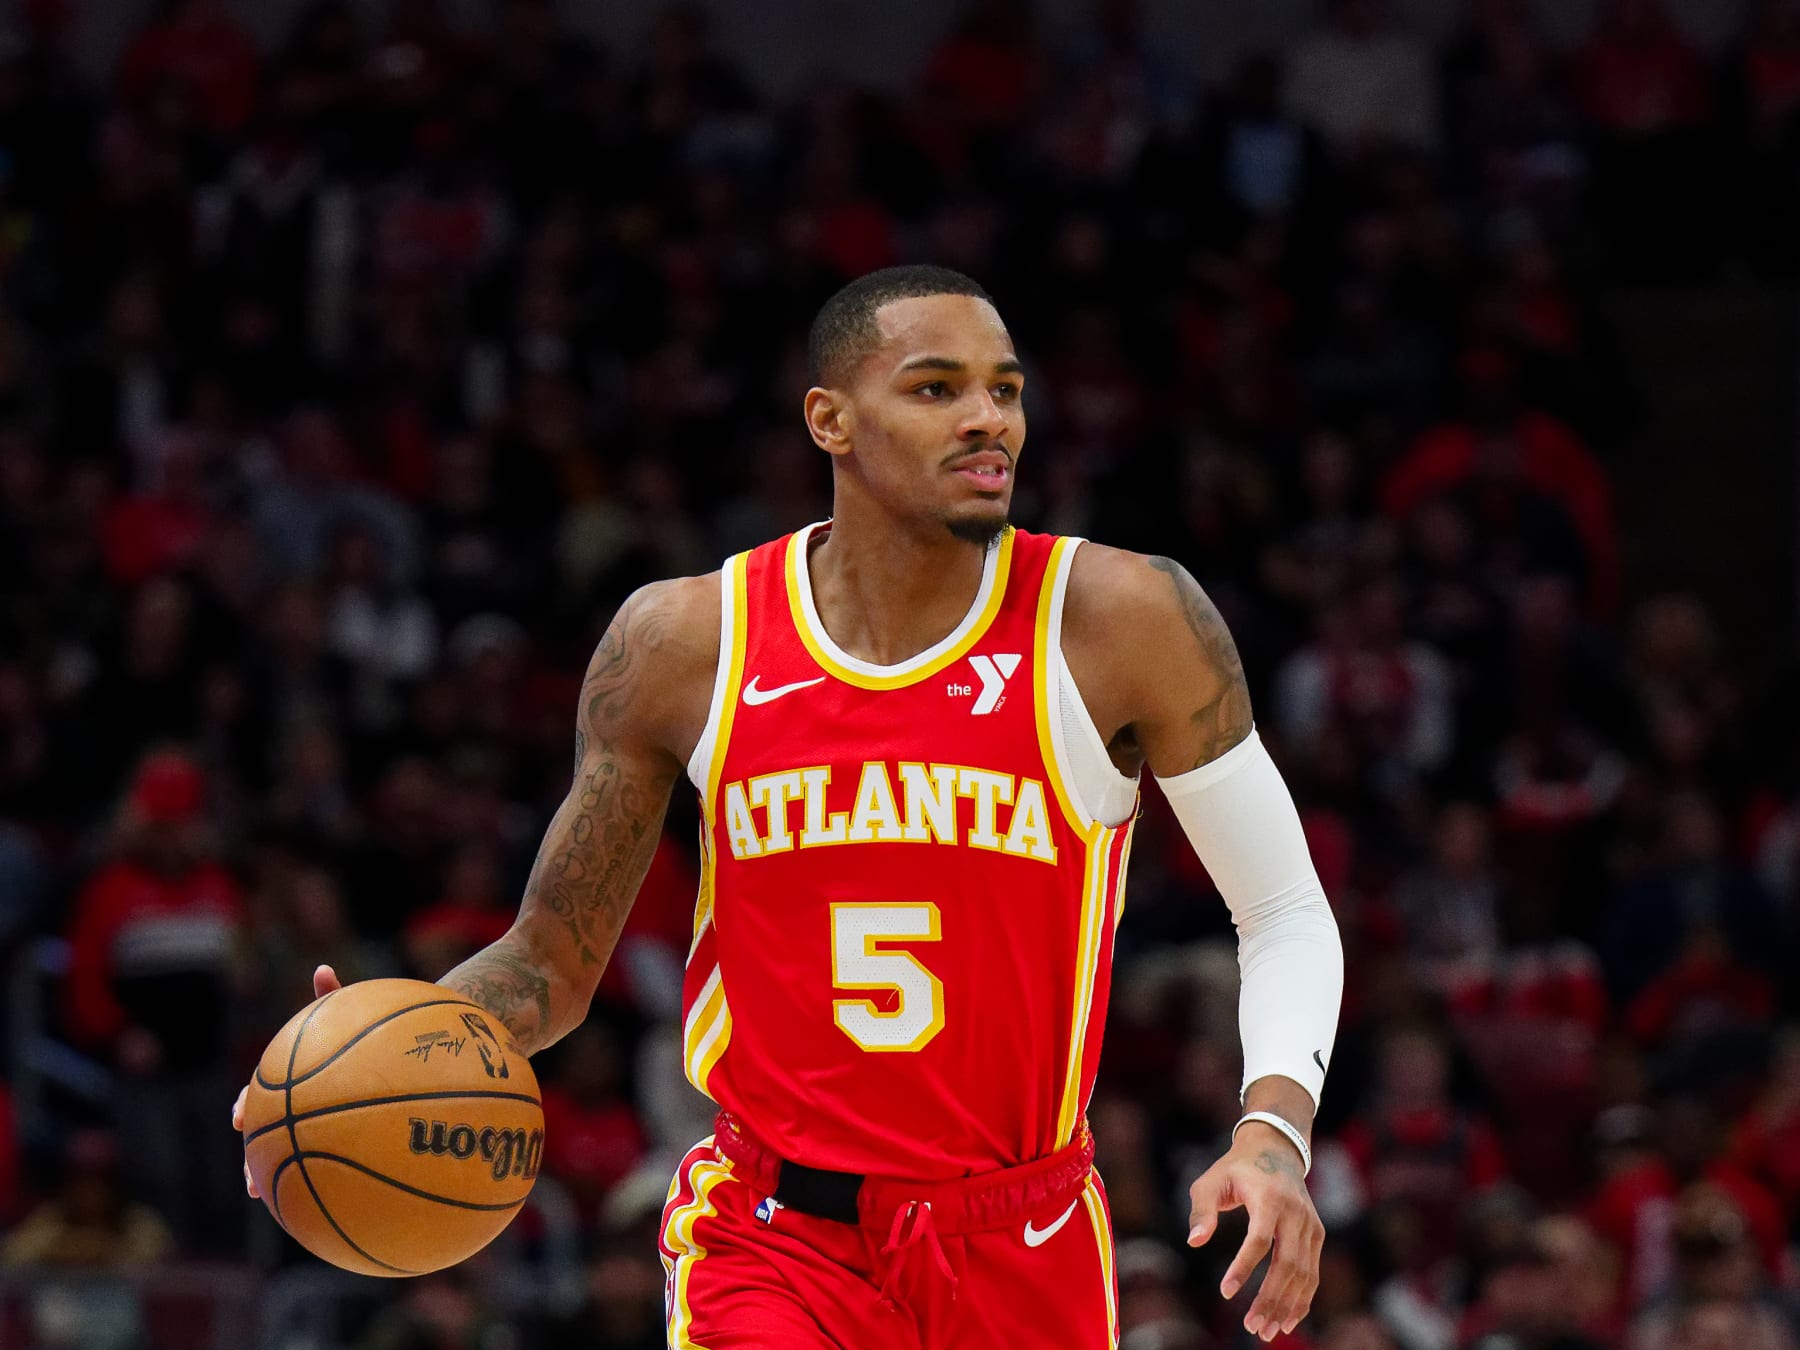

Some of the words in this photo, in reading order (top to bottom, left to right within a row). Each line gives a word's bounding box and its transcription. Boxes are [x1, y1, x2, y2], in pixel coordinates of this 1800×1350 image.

[947, 683, 972, 697] the
[725, 761, 1058, 866] ATLANTA
[829, 901, 945, 1053] 5
